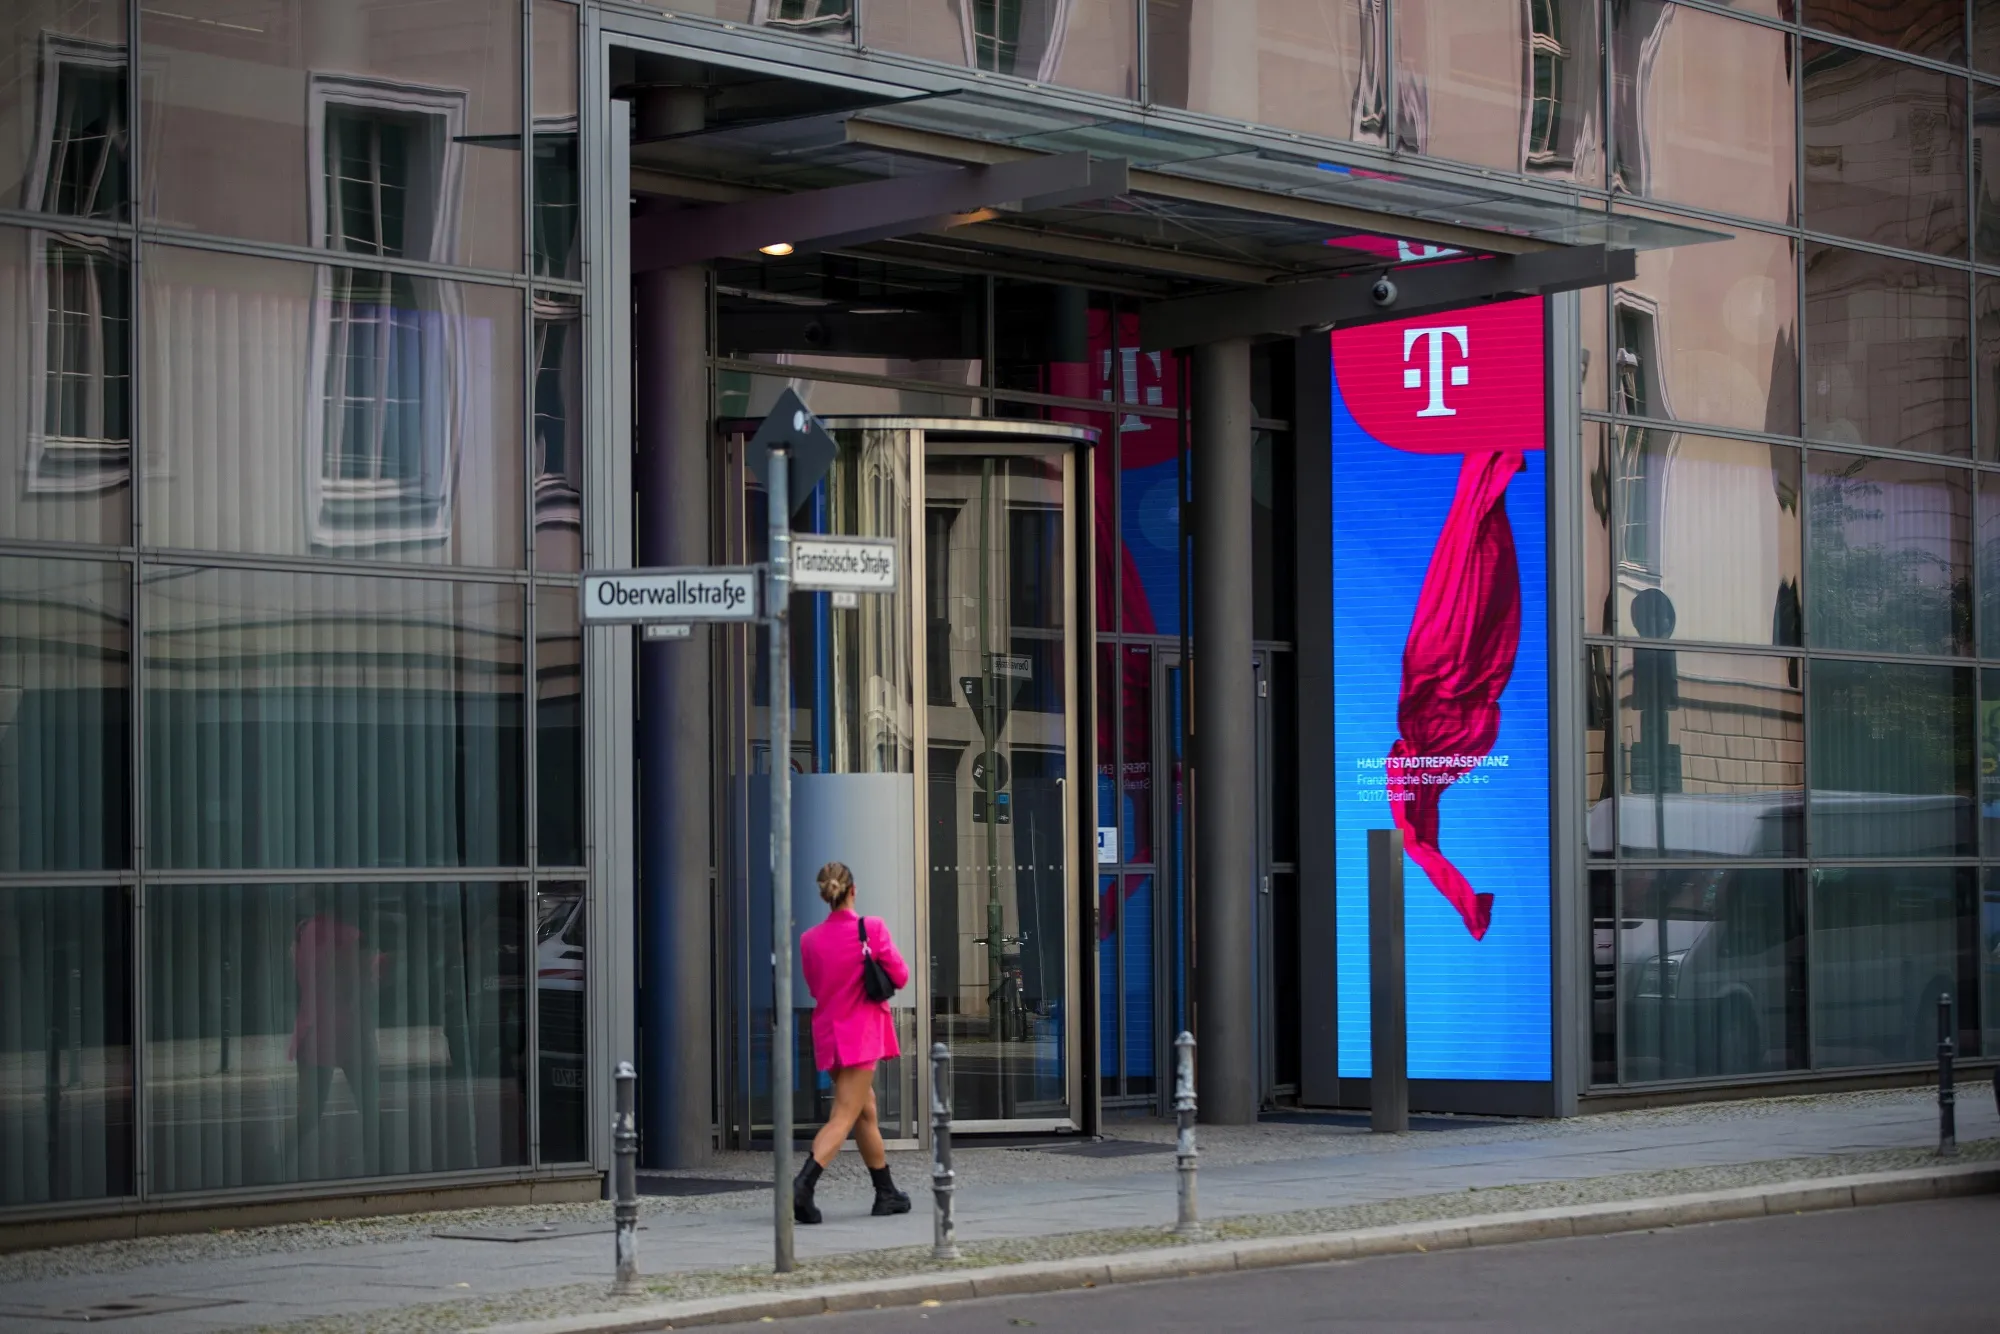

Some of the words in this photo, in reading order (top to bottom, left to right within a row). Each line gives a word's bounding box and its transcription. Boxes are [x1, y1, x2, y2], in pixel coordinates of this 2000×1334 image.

[1404, 326, 1469, 417] T
[796, 546, 858, 573] Französische
[860, 548, 891, 581] Straße
[598, 578, 746, 610] Oberwallstraße
[1356, 754, 1509, 769] HAUPTSTADTREPRÄSENTANZ
[1357, 772, 1420, 785] Französische
[1421, 772, 1456, 785] Straße
[1457, 772, 1471, 784] 33
[1357, 789, 1384, 802] 10117
[1387, 789, 1416, 802] Berlin
